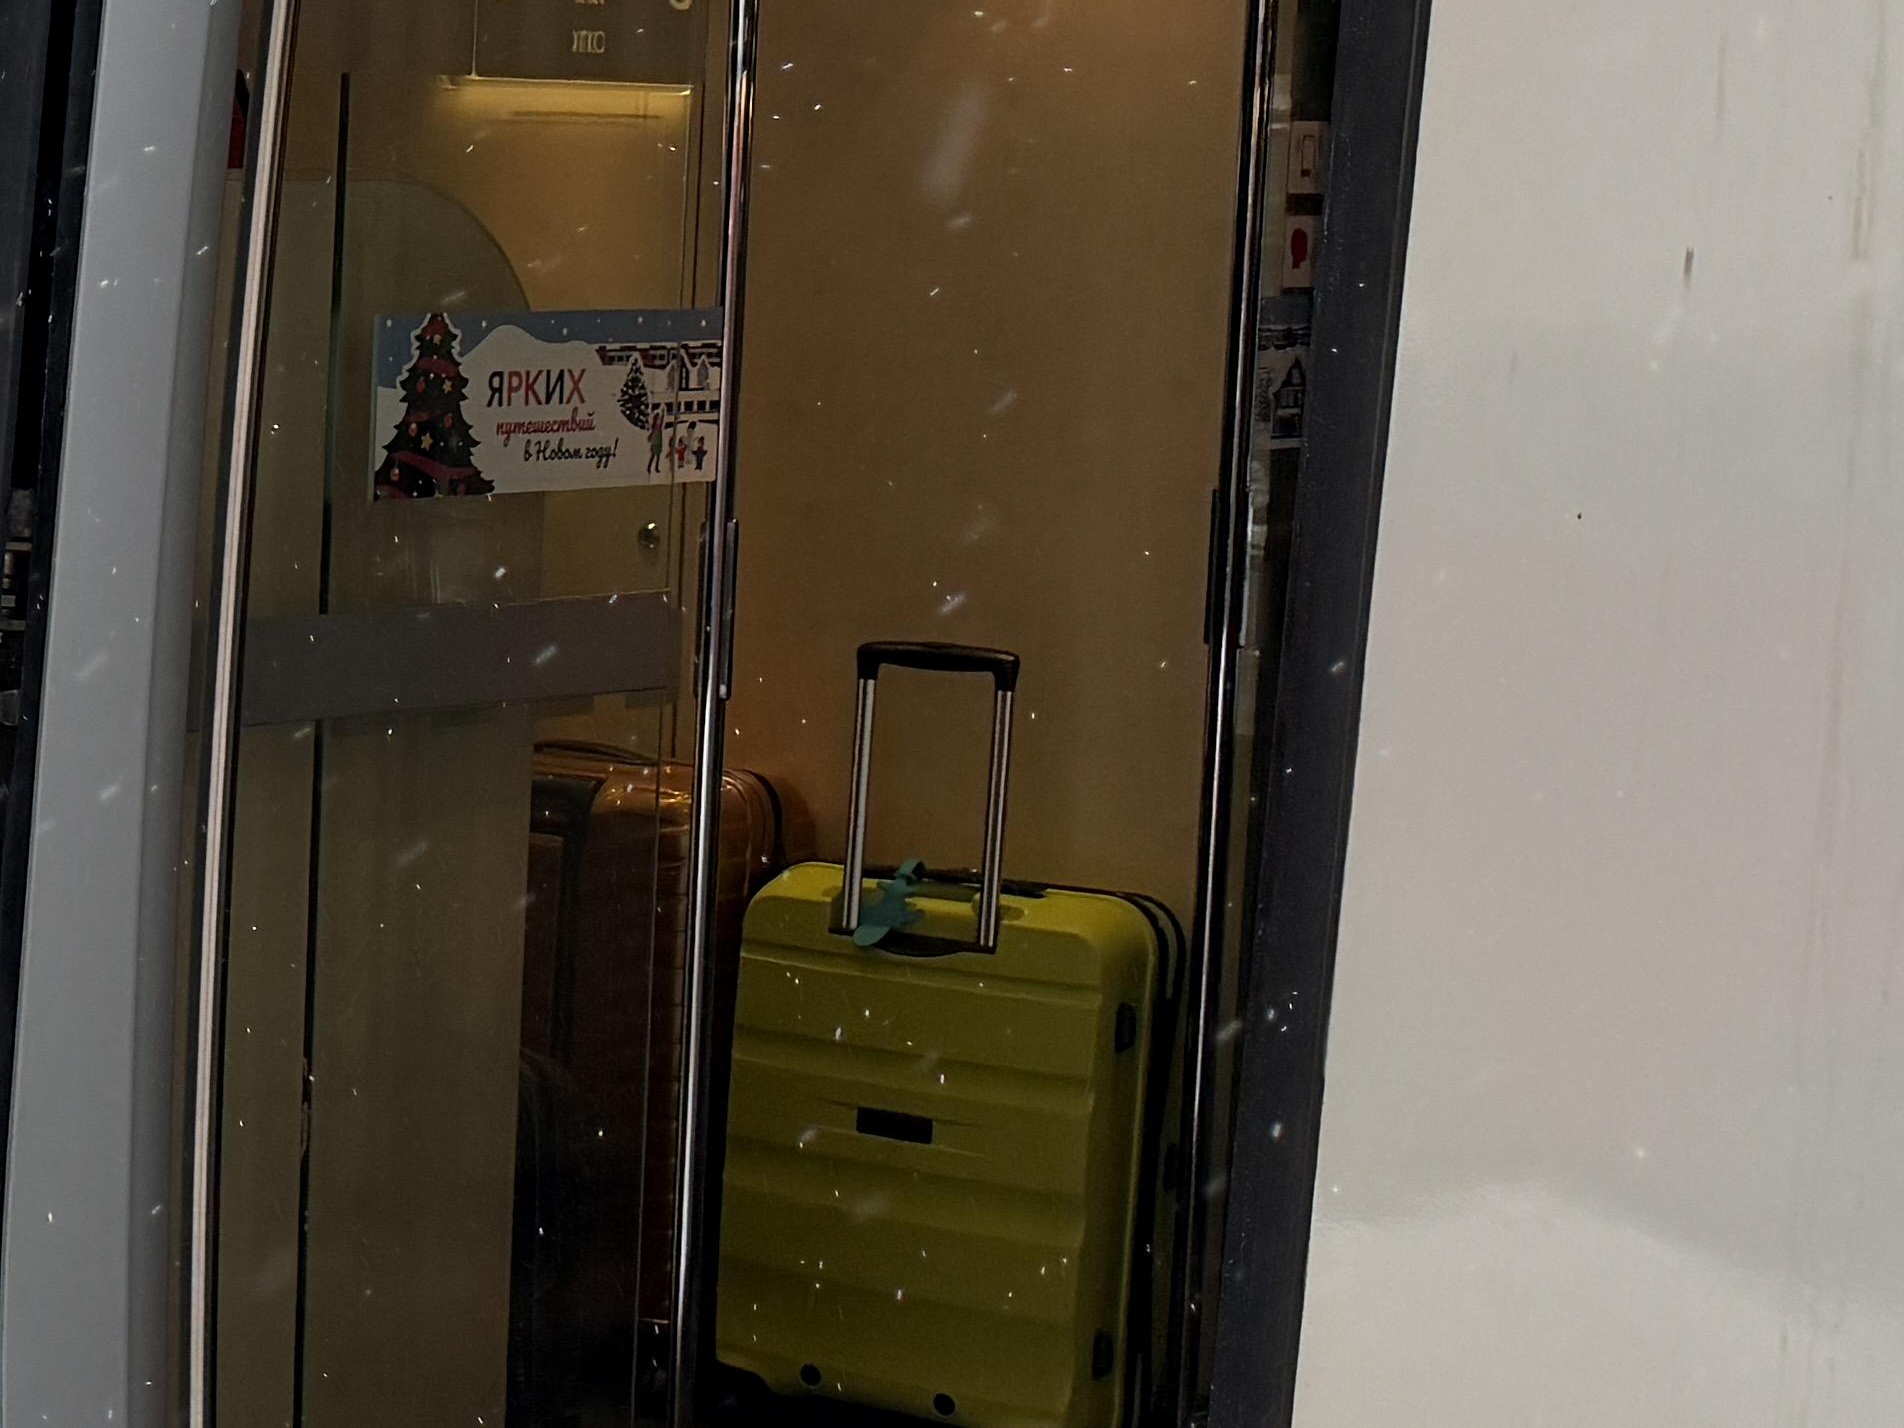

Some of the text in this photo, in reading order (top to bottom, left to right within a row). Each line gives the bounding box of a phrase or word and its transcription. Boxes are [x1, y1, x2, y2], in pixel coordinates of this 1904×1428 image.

[486, 368, 587, 407] ЯРКИХ
[495, 406, 596, 448] путешествий
[523, 436, 619, 469] в Новом году!
